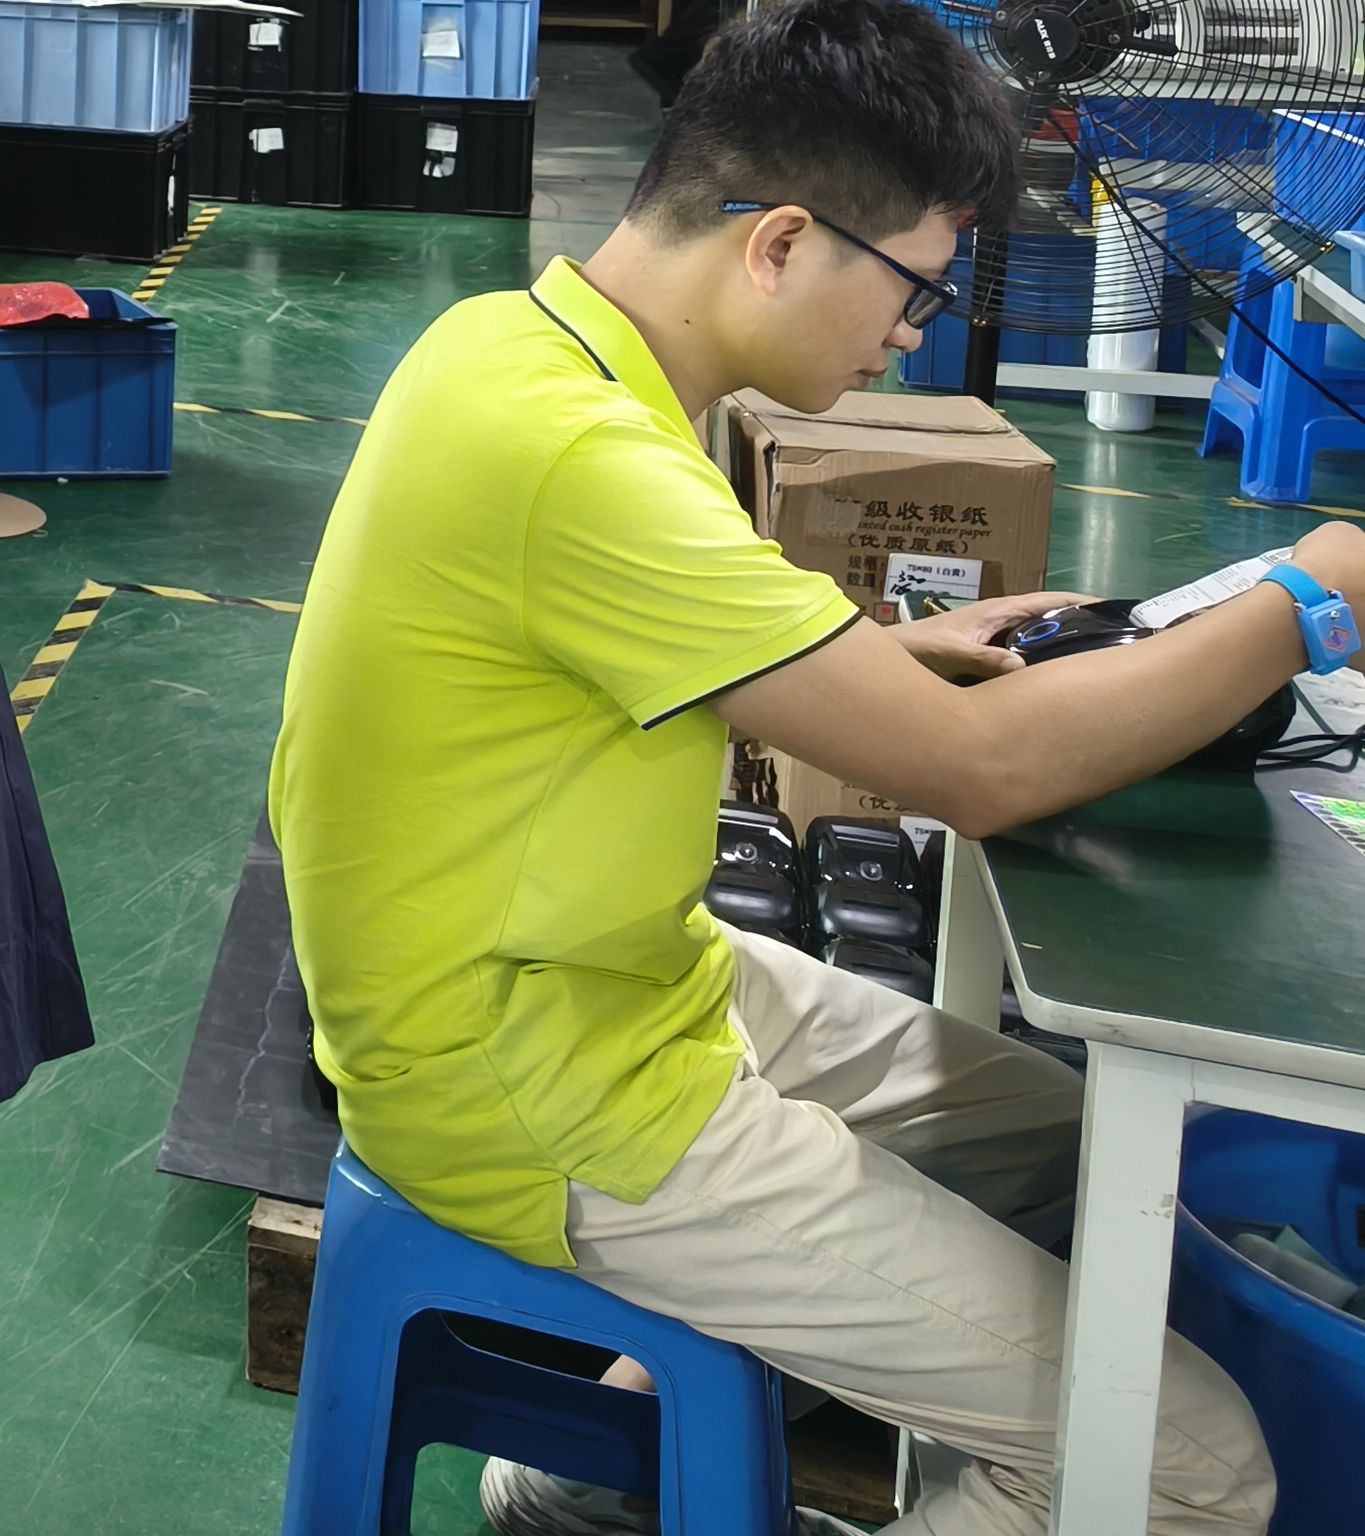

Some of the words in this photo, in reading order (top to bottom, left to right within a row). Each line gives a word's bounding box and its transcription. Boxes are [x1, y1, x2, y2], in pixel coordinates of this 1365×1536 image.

[835, 498, 989, 526] 级收银纸
[958, 528, 992, 540] paper
